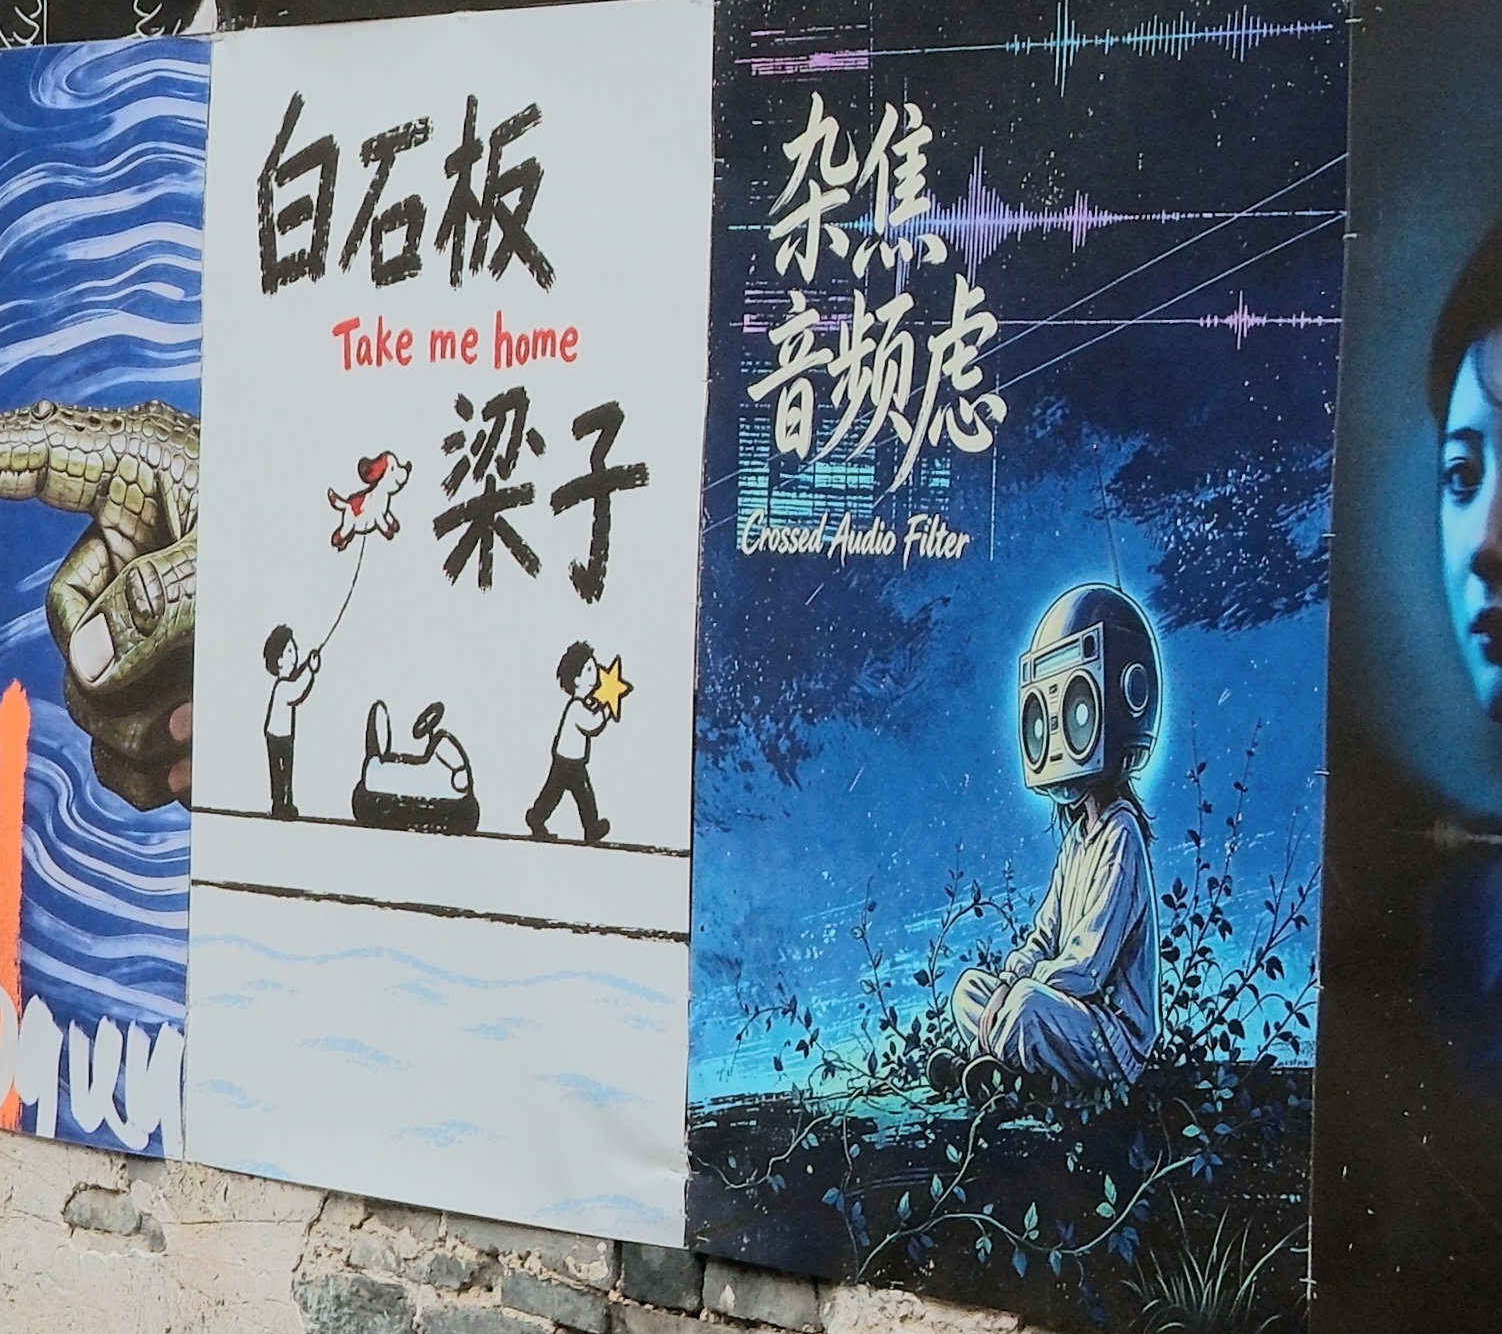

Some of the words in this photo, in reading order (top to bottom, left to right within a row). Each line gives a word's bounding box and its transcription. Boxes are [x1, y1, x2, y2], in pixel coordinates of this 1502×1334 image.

[257, 91, 557, 296] 白石板
[332, 316, 413, 371] Take
[427, 324, 479, 365] me
[493, 310, 580, 370] home
[433, 384, 648, 606] 梁子
[741, 503, 829, 558] Crossed
[827, 511, 896, 568] Audio
[903, 513, 971, 571] Filter
